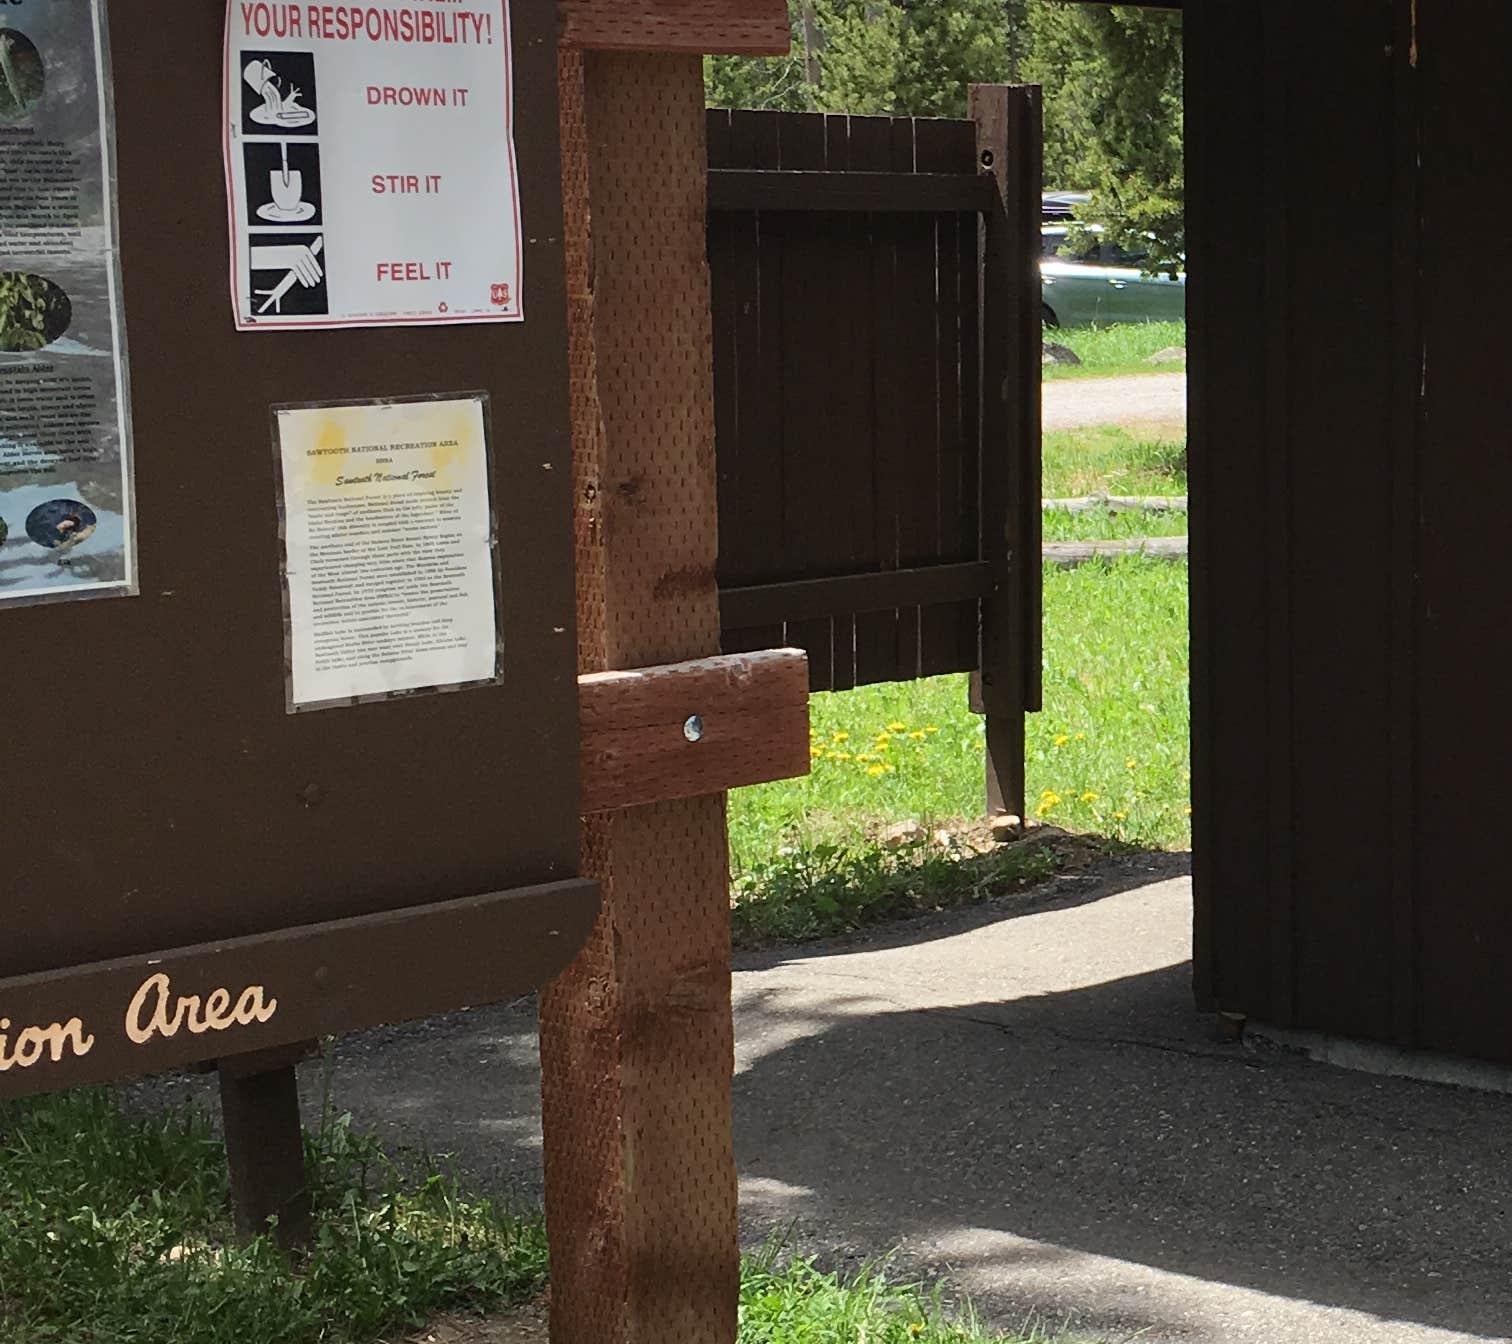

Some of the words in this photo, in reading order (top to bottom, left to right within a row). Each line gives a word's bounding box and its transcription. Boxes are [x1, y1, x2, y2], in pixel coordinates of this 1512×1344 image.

[241, 2, 310, 38] YOUR
[309, 5, 493, 44] RESPONSIBILITY!
[366, 86, 446, 107] DROWN
[453, 88, 468, 107] IT
[371, 175, 418, 194] STIR
[425, 175, 441, 193] IT
[377, 262, 431, 281] FEEL
[436, 262, 452, 280] IT
[306, 447, 349, 456] SAWTOOTH
[351, 445, 388, 454] NATIONAL
[390, 441, 437, 451] RECREATION
[125, 971, 278, 1045] Area
